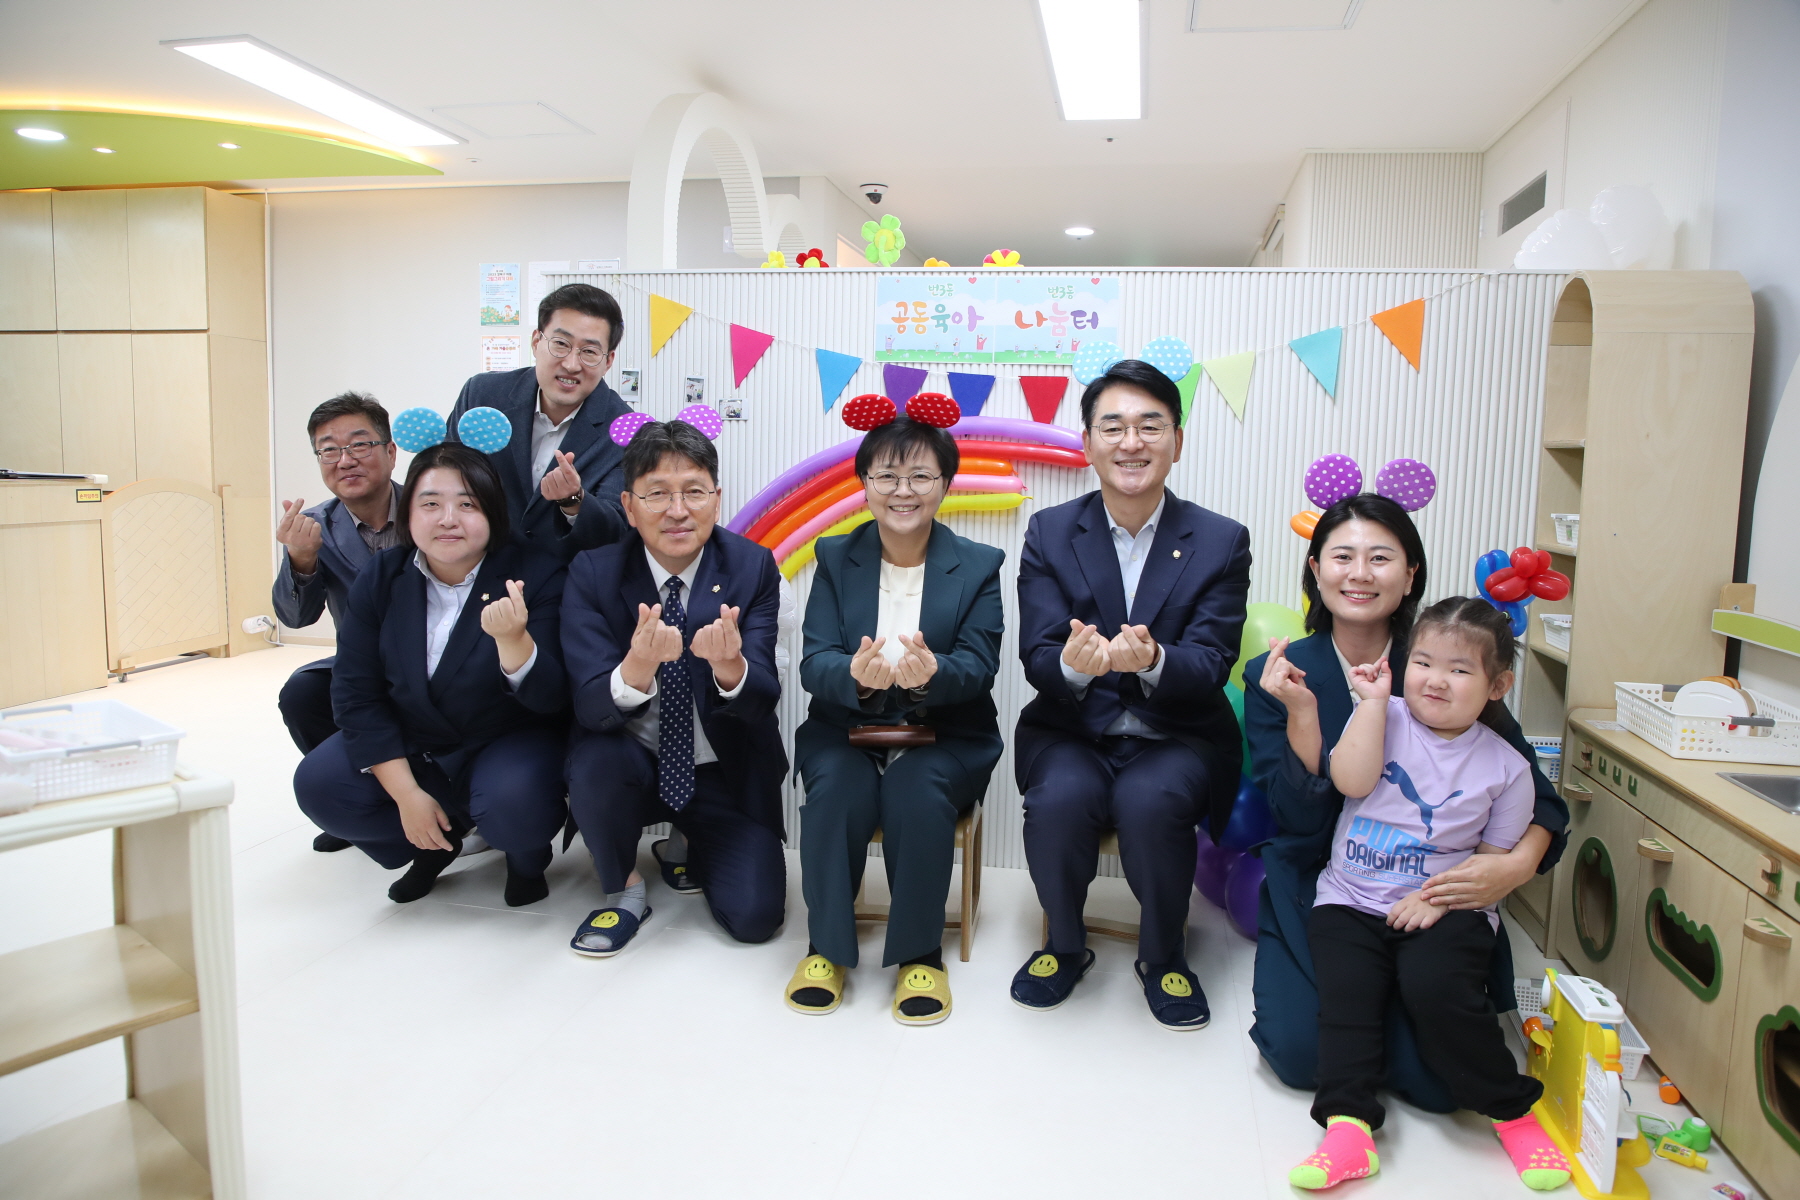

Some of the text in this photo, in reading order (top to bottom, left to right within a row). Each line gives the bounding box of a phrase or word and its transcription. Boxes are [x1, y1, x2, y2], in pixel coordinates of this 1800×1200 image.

[928, 283, 954, 297] 번3동
[1047, 285, 1075, 299] 번3동
[891, 301, 984, 334] 공동육아
[1014, 302, 1099, 337] 나눔터
[1342, 861, 1376, 878] SPORTING
[1346, 839, 1431, 878] ORIGINAL
